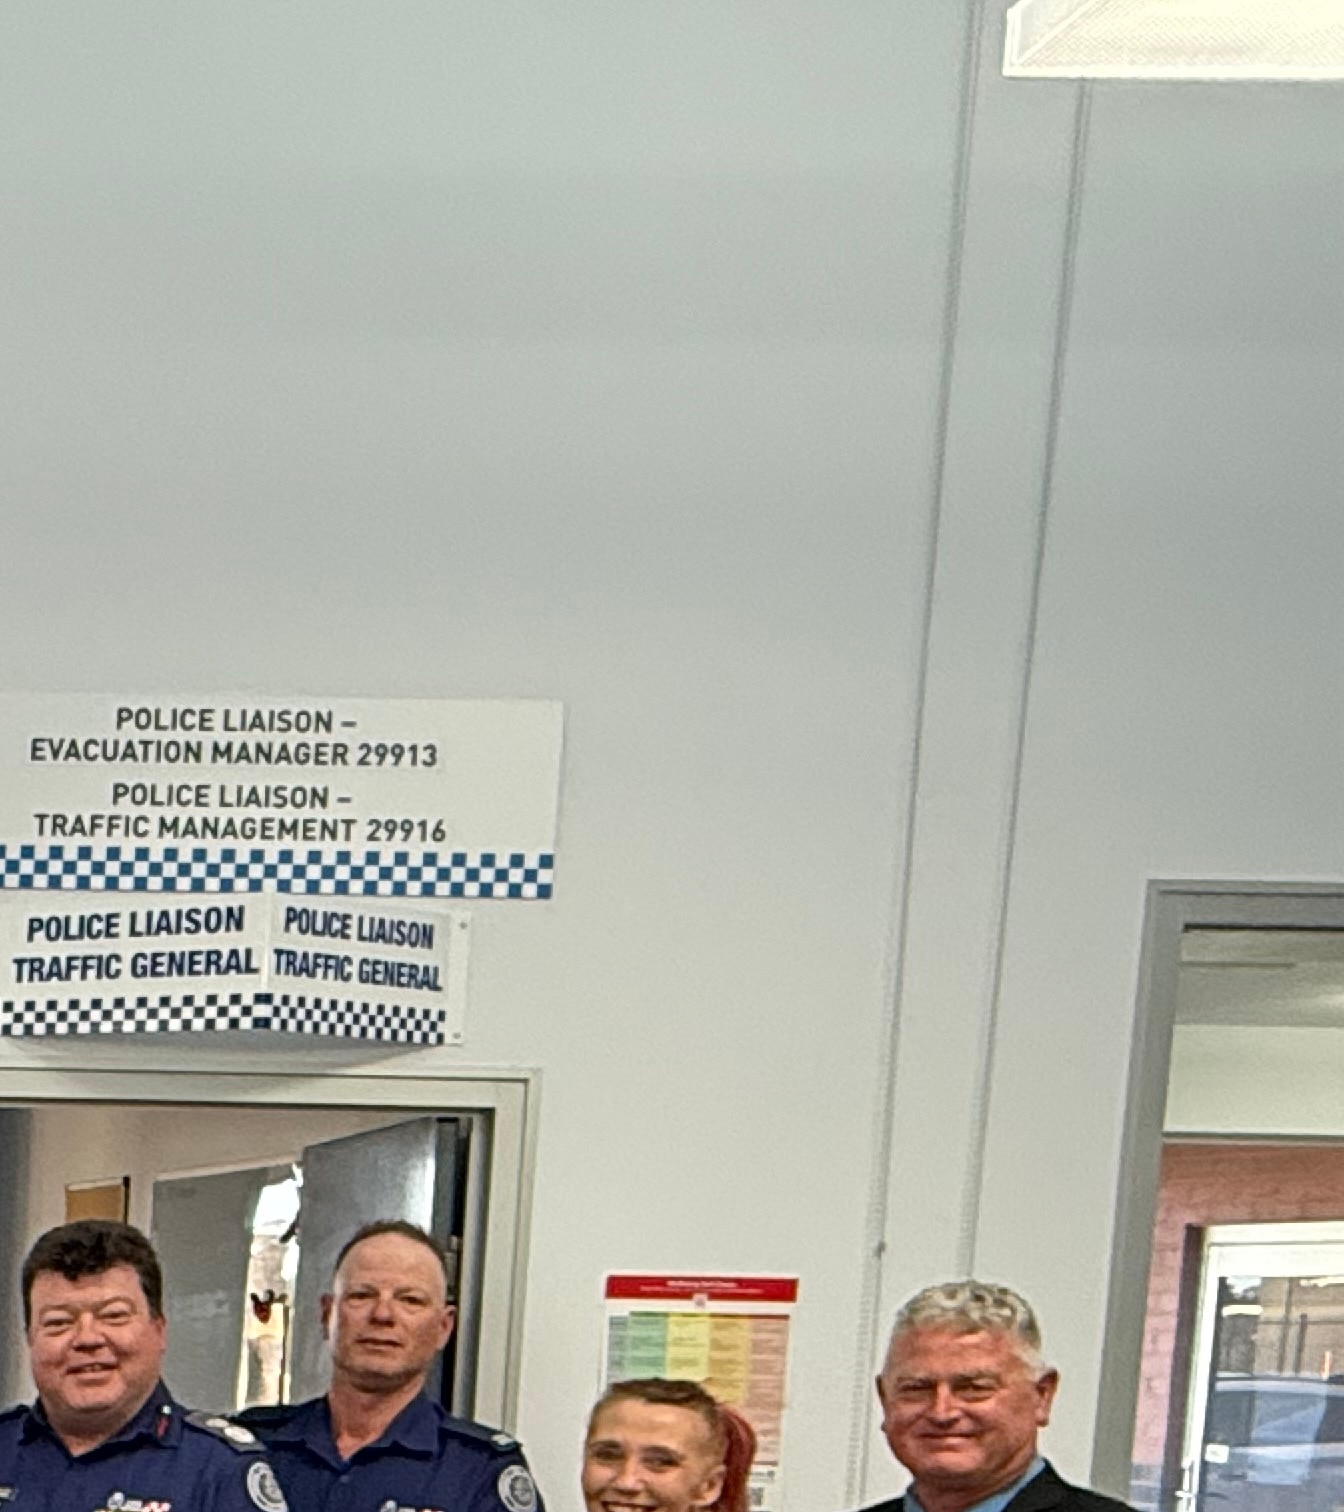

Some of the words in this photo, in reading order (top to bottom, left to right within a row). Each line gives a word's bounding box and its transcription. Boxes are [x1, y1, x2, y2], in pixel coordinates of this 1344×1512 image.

[116, 707, 215, 731] POLICE
[223, 709, 333, 733] LIAISON
[31, 738, 202, 764] EVACUATION
[211, 741, 349, 766] MANAGER
[357, 743, 437, 767] 29913
[112, 783, 211, 807] POLICE
[219, 784, 329, 809] LIAISON
[33, 814, 150, 837] TRAFFIC
[157, 816, 357, 841] MANAGEMENT
[367, 819, 446, 842] 29916
[27, 912, 121, 942] POLICE
[129, 905, 245, 937] LIAISON
[284, 906, 353, 940] POLICE
[357, 915, 435, 950] LIAISON
[13, 953, 122, 983] TRAFFIC
[131, 947, 261, 978] GENERAL
[273, 948, 353, 983] TRAFFIC
[358, 958, 443, 991] GENERAL
